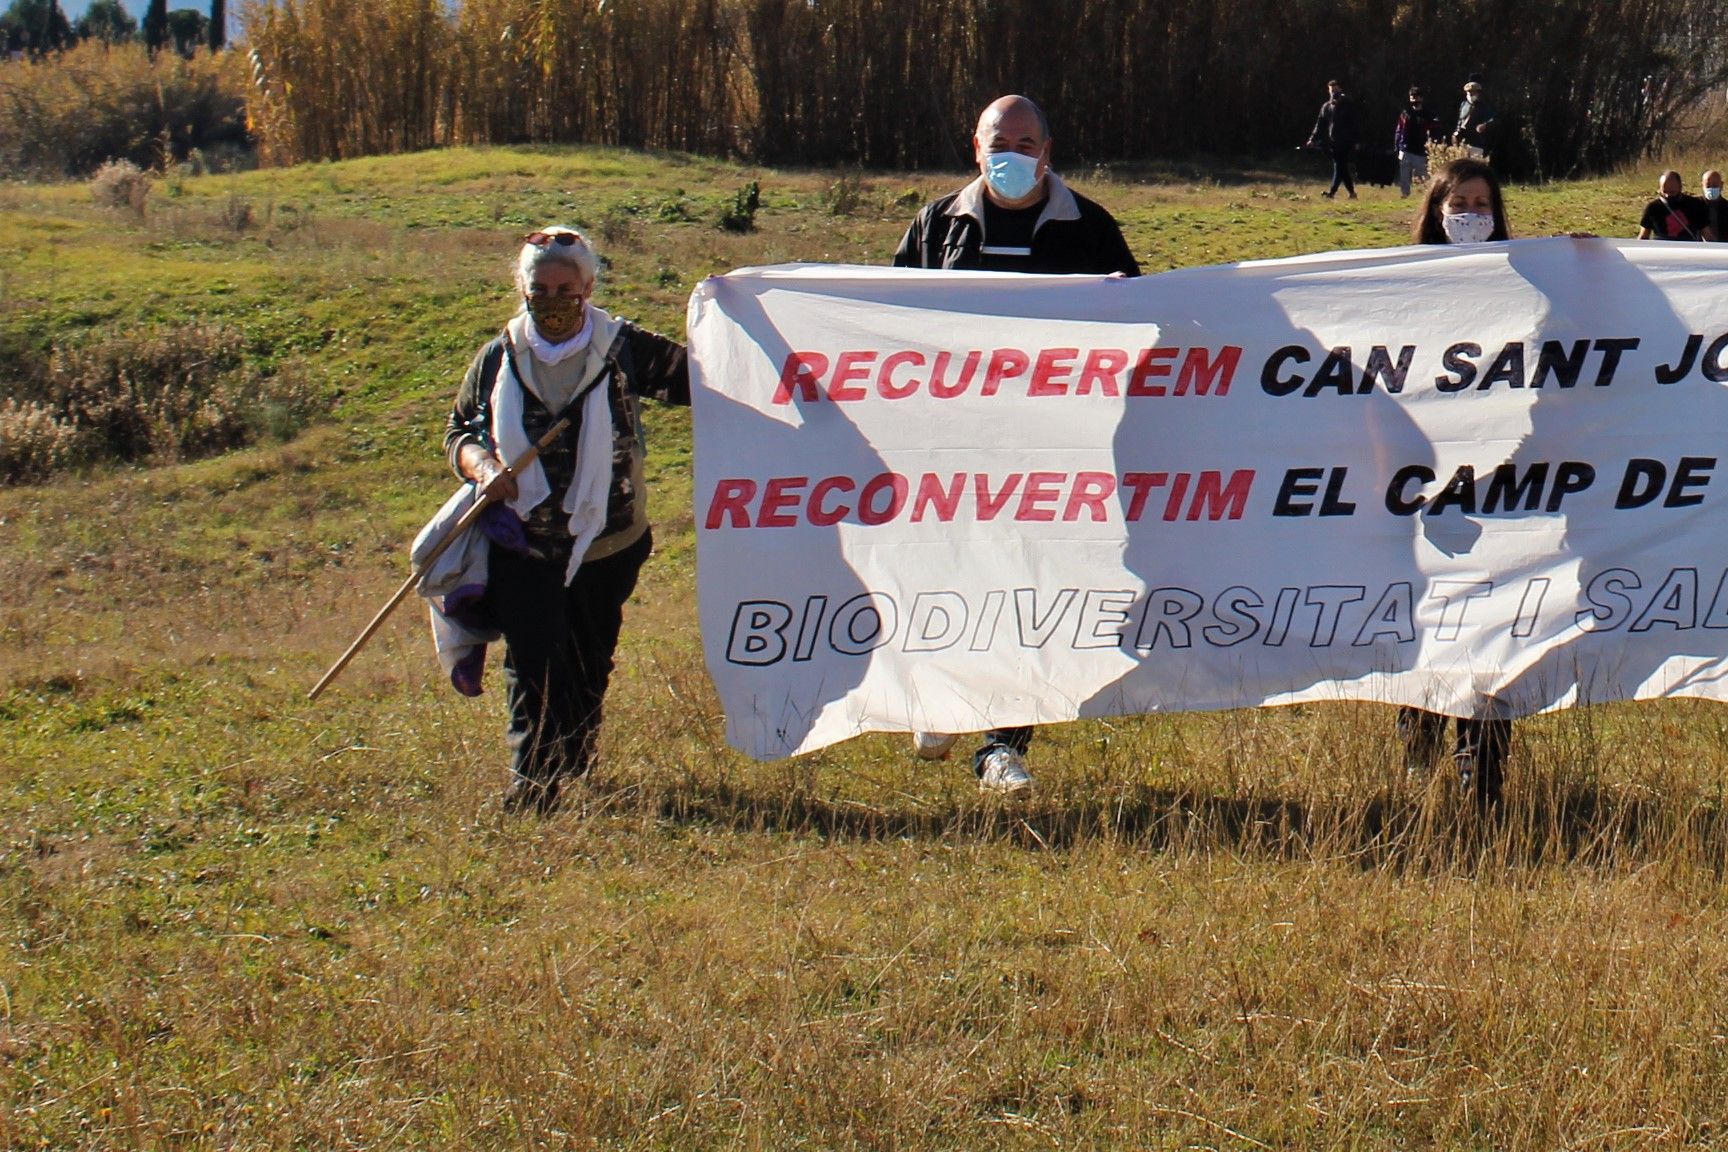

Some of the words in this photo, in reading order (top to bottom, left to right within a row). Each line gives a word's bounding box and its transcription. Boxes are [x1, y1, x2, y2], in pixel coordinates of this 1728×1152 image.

[771, 346, 1242, 405] RECUPEREM
[1260, 344, 1416, 397] CAN
[1434, 337, 1640, 394] SANT
[705, 469, 1255, 530] RECONVERTIM
[1272, 466, 1356, 517] EL
[1384, 461, 1595, 516] CAMP
[1615, 457, 1717, 510] DE
[726, 580, 1492, 665] BIODIVERSITAT
[1511, 578, 1551, 638] I
